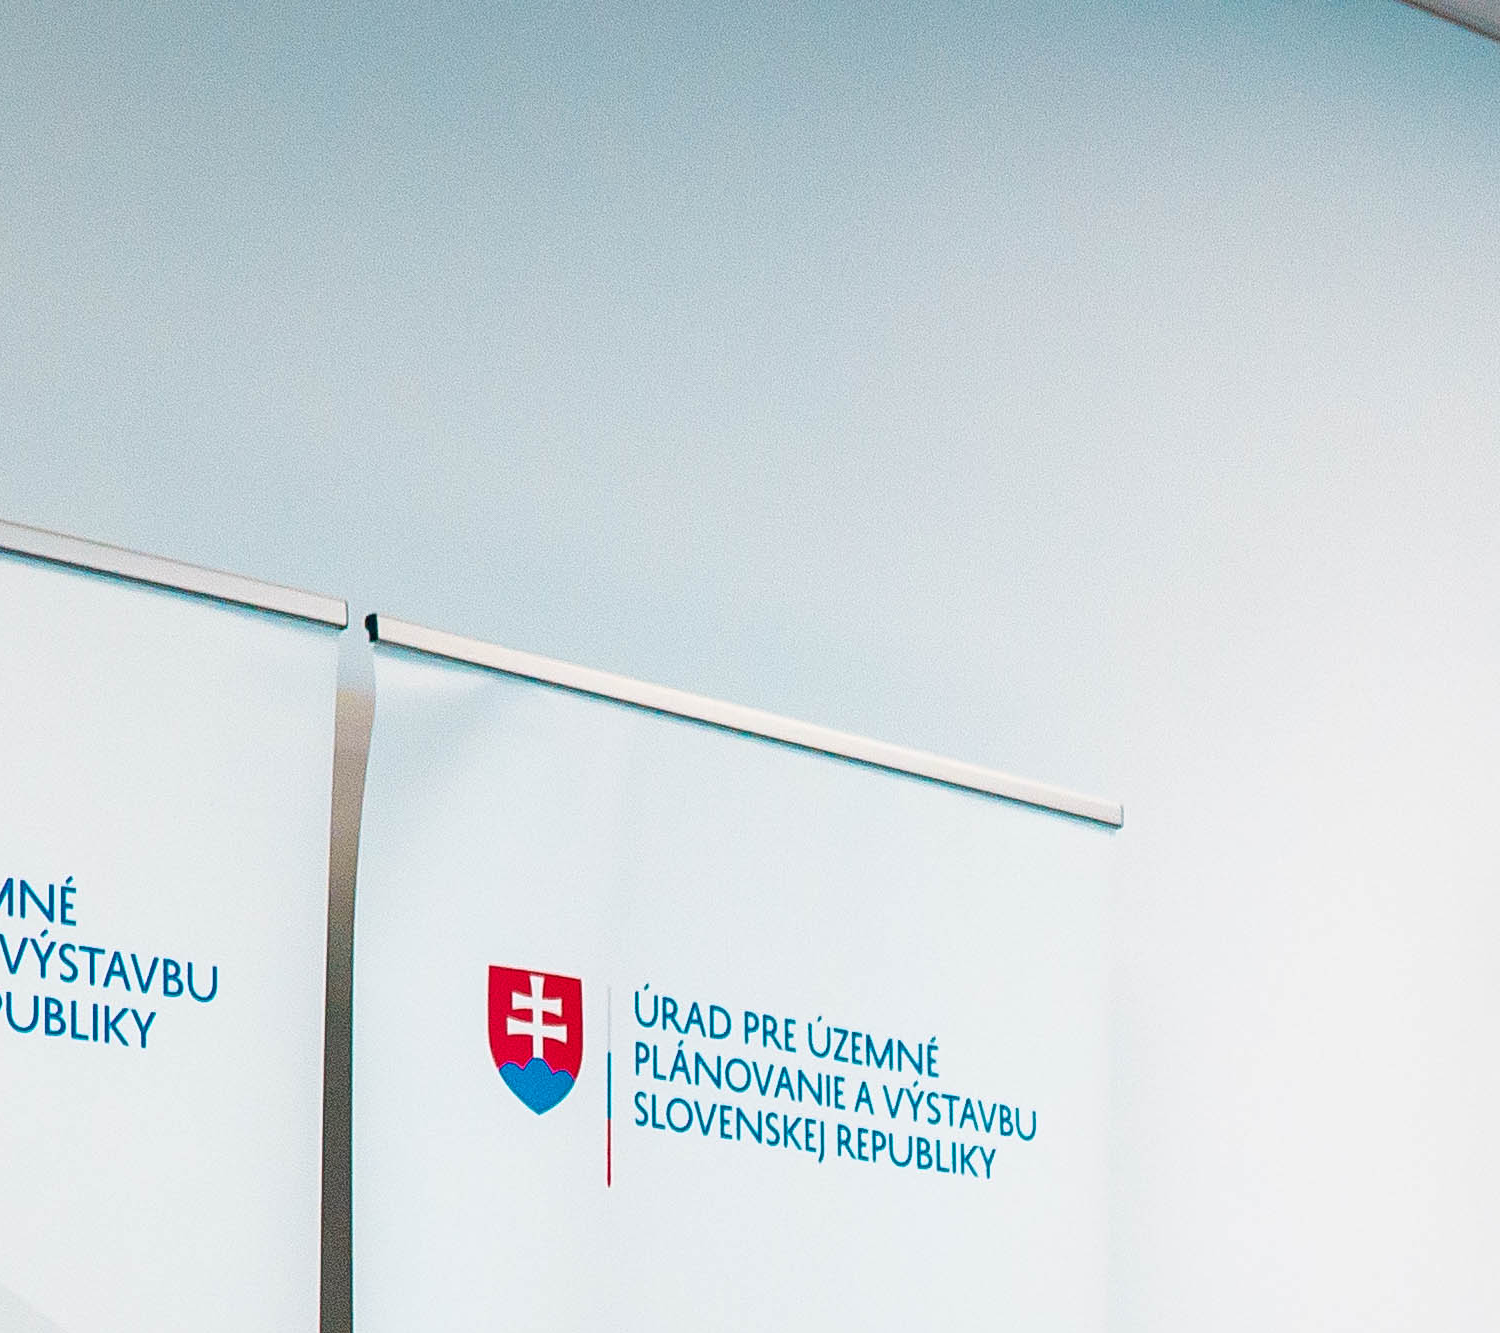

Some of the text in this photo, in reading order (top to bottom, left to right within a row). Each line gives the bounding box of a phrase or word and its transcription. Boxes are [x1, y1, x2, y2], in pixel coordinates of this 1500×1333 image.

[634, 983, 940, 1079] ÚRAD PRE ÚZEMNÉ
[633, 1090, 997, 1180] SLOVENSKEJ REPUBLIKY
[634, 1039, 1037, 1142] PLÁNOVANIE A VÝSTAVBU
